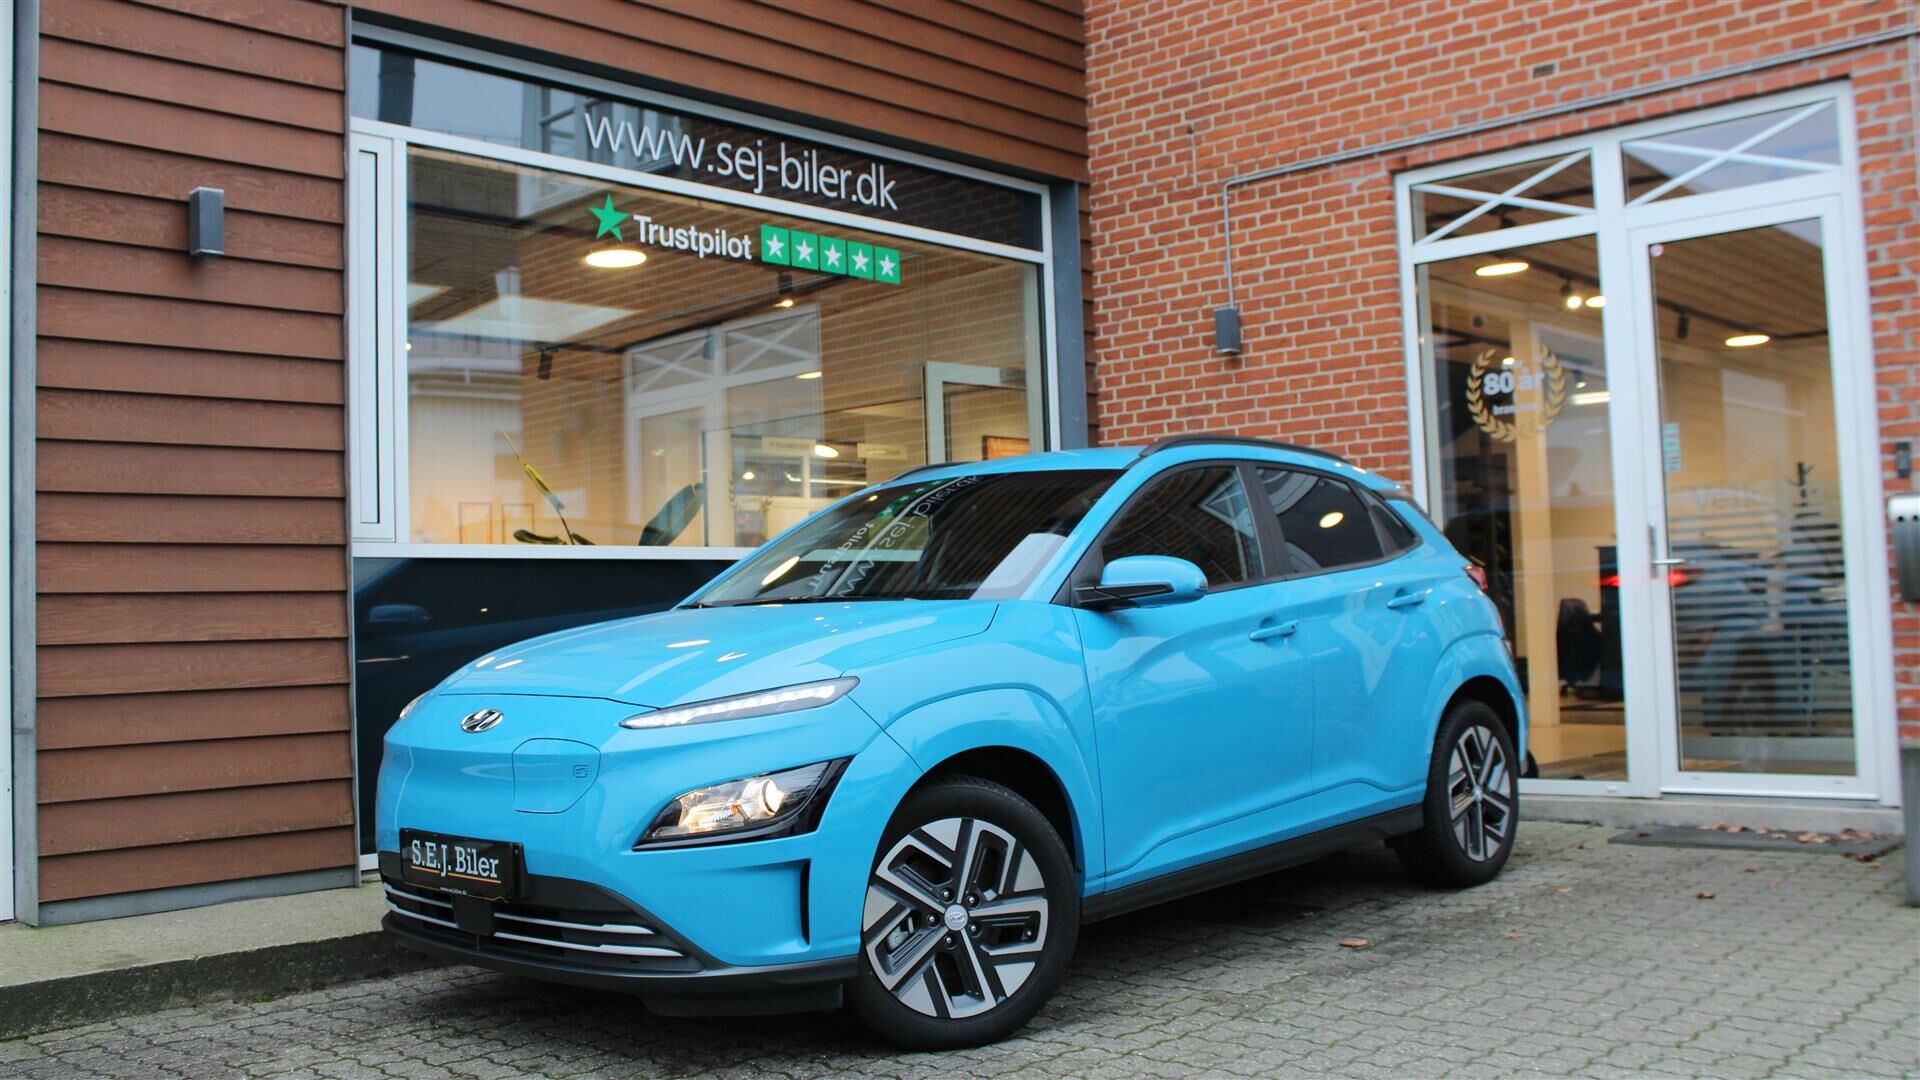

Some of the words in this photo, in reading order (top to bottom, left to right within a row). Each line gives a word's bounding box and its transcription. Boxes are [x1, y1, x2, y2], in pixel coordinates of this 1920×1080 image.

[584, 112, 899, 211] www.sej-biler.dk
[632, 214, 752, 261] Trustpilot
[1483, 371, 1513, 396] 80
[411, 839, 452, 877] S.E.J.
[455, 846, 499, 879] Biler
